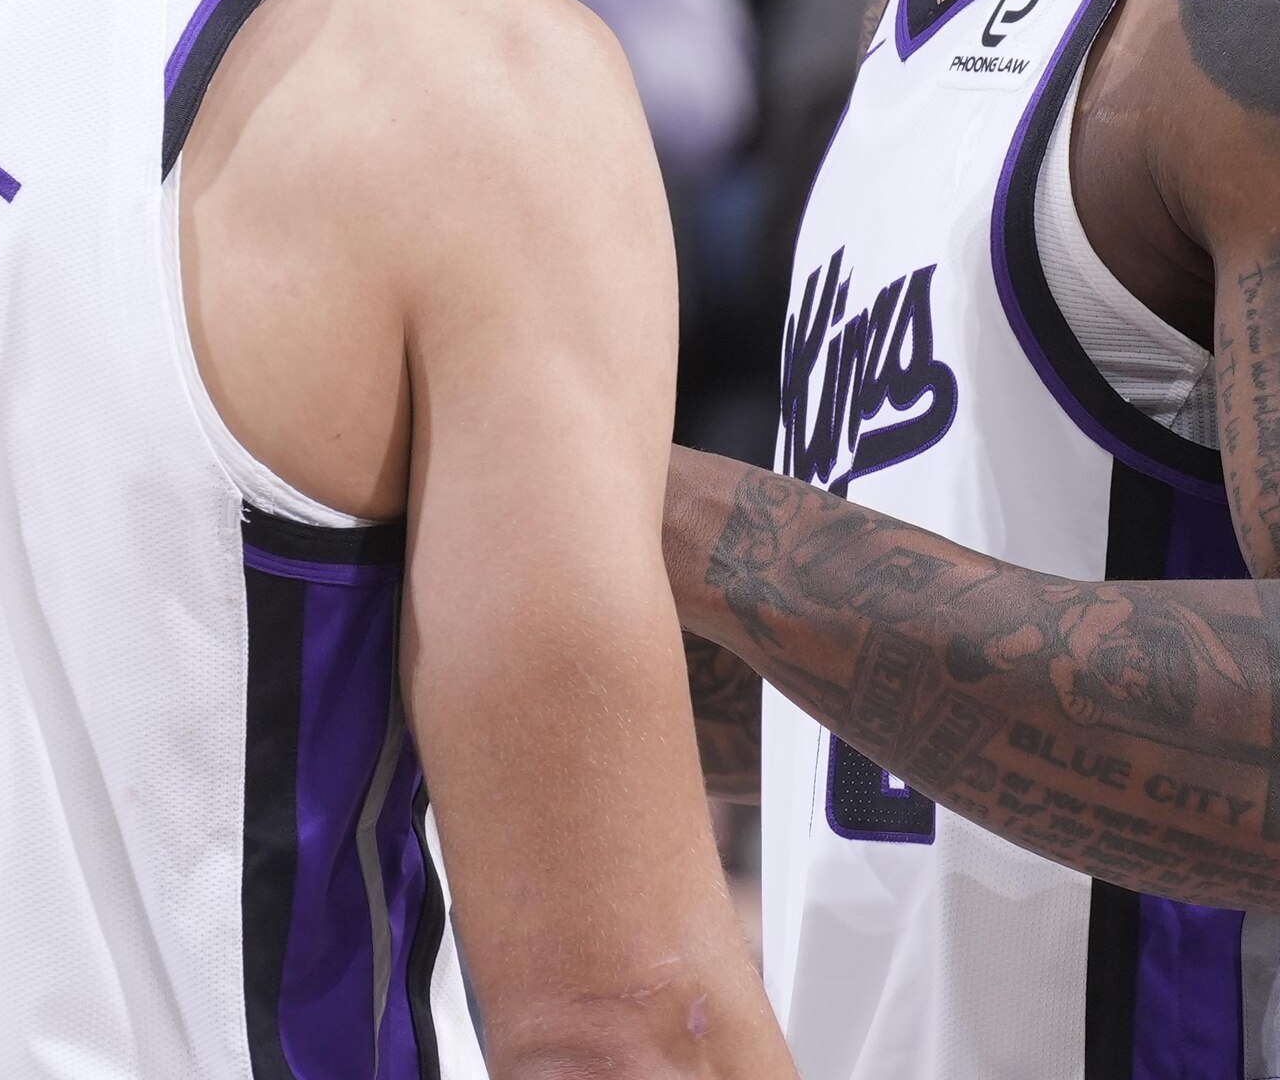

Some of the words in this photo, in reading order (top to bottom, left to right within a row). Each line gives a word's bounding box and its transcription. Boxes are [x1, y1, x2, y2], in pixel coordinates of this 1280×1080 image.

[949, 56, 997, 72] PHOONG
[997, 57, 1030, 74] LAW
[782, 244, 959, 500] Kings
[1008, 721, 1132, 792] BLUE
[1144, 774, 1256, 826] CITY
